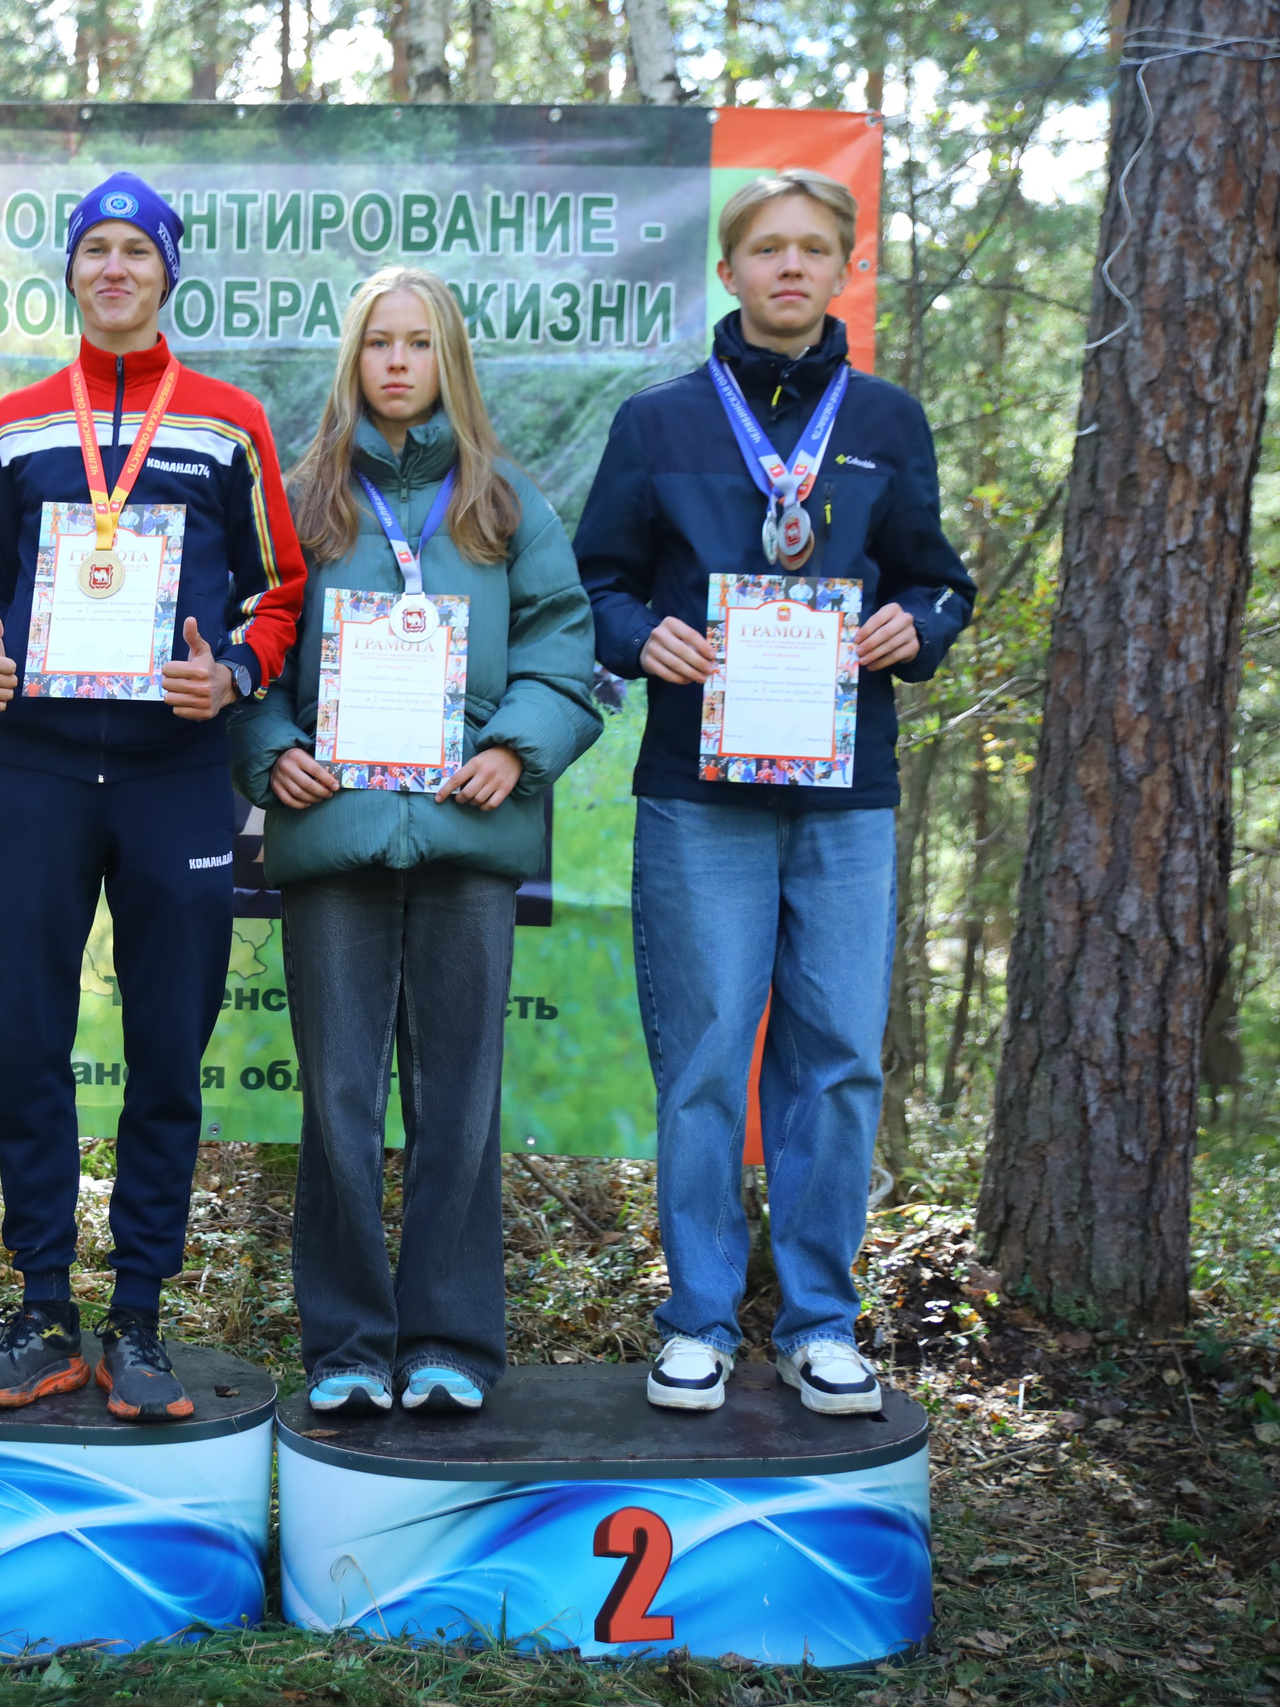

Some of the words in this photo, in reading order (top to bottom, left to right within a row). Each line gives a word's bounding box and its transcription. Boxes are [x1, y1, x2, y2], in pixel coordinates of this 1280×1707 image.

[3, 188, 619, 256] ОРНТИРОВАНИЕ
[172, 276, 368, 341] ОБРА
[451, 281, 674, 344] ЖИЗНИ
[74, 372, 85, 409] ОБЛАСТЬ
[80, 410, 98, 475] ЧЕЛЯБИНСКАЯ
[127, 433, 150, 474] ОБЛАСТЬ
[147, 457, 210, 478] КОМАНДА74
[740, 624, 826, 639] ГРАМОТА
[592, 1506, 676, 1644] 2
